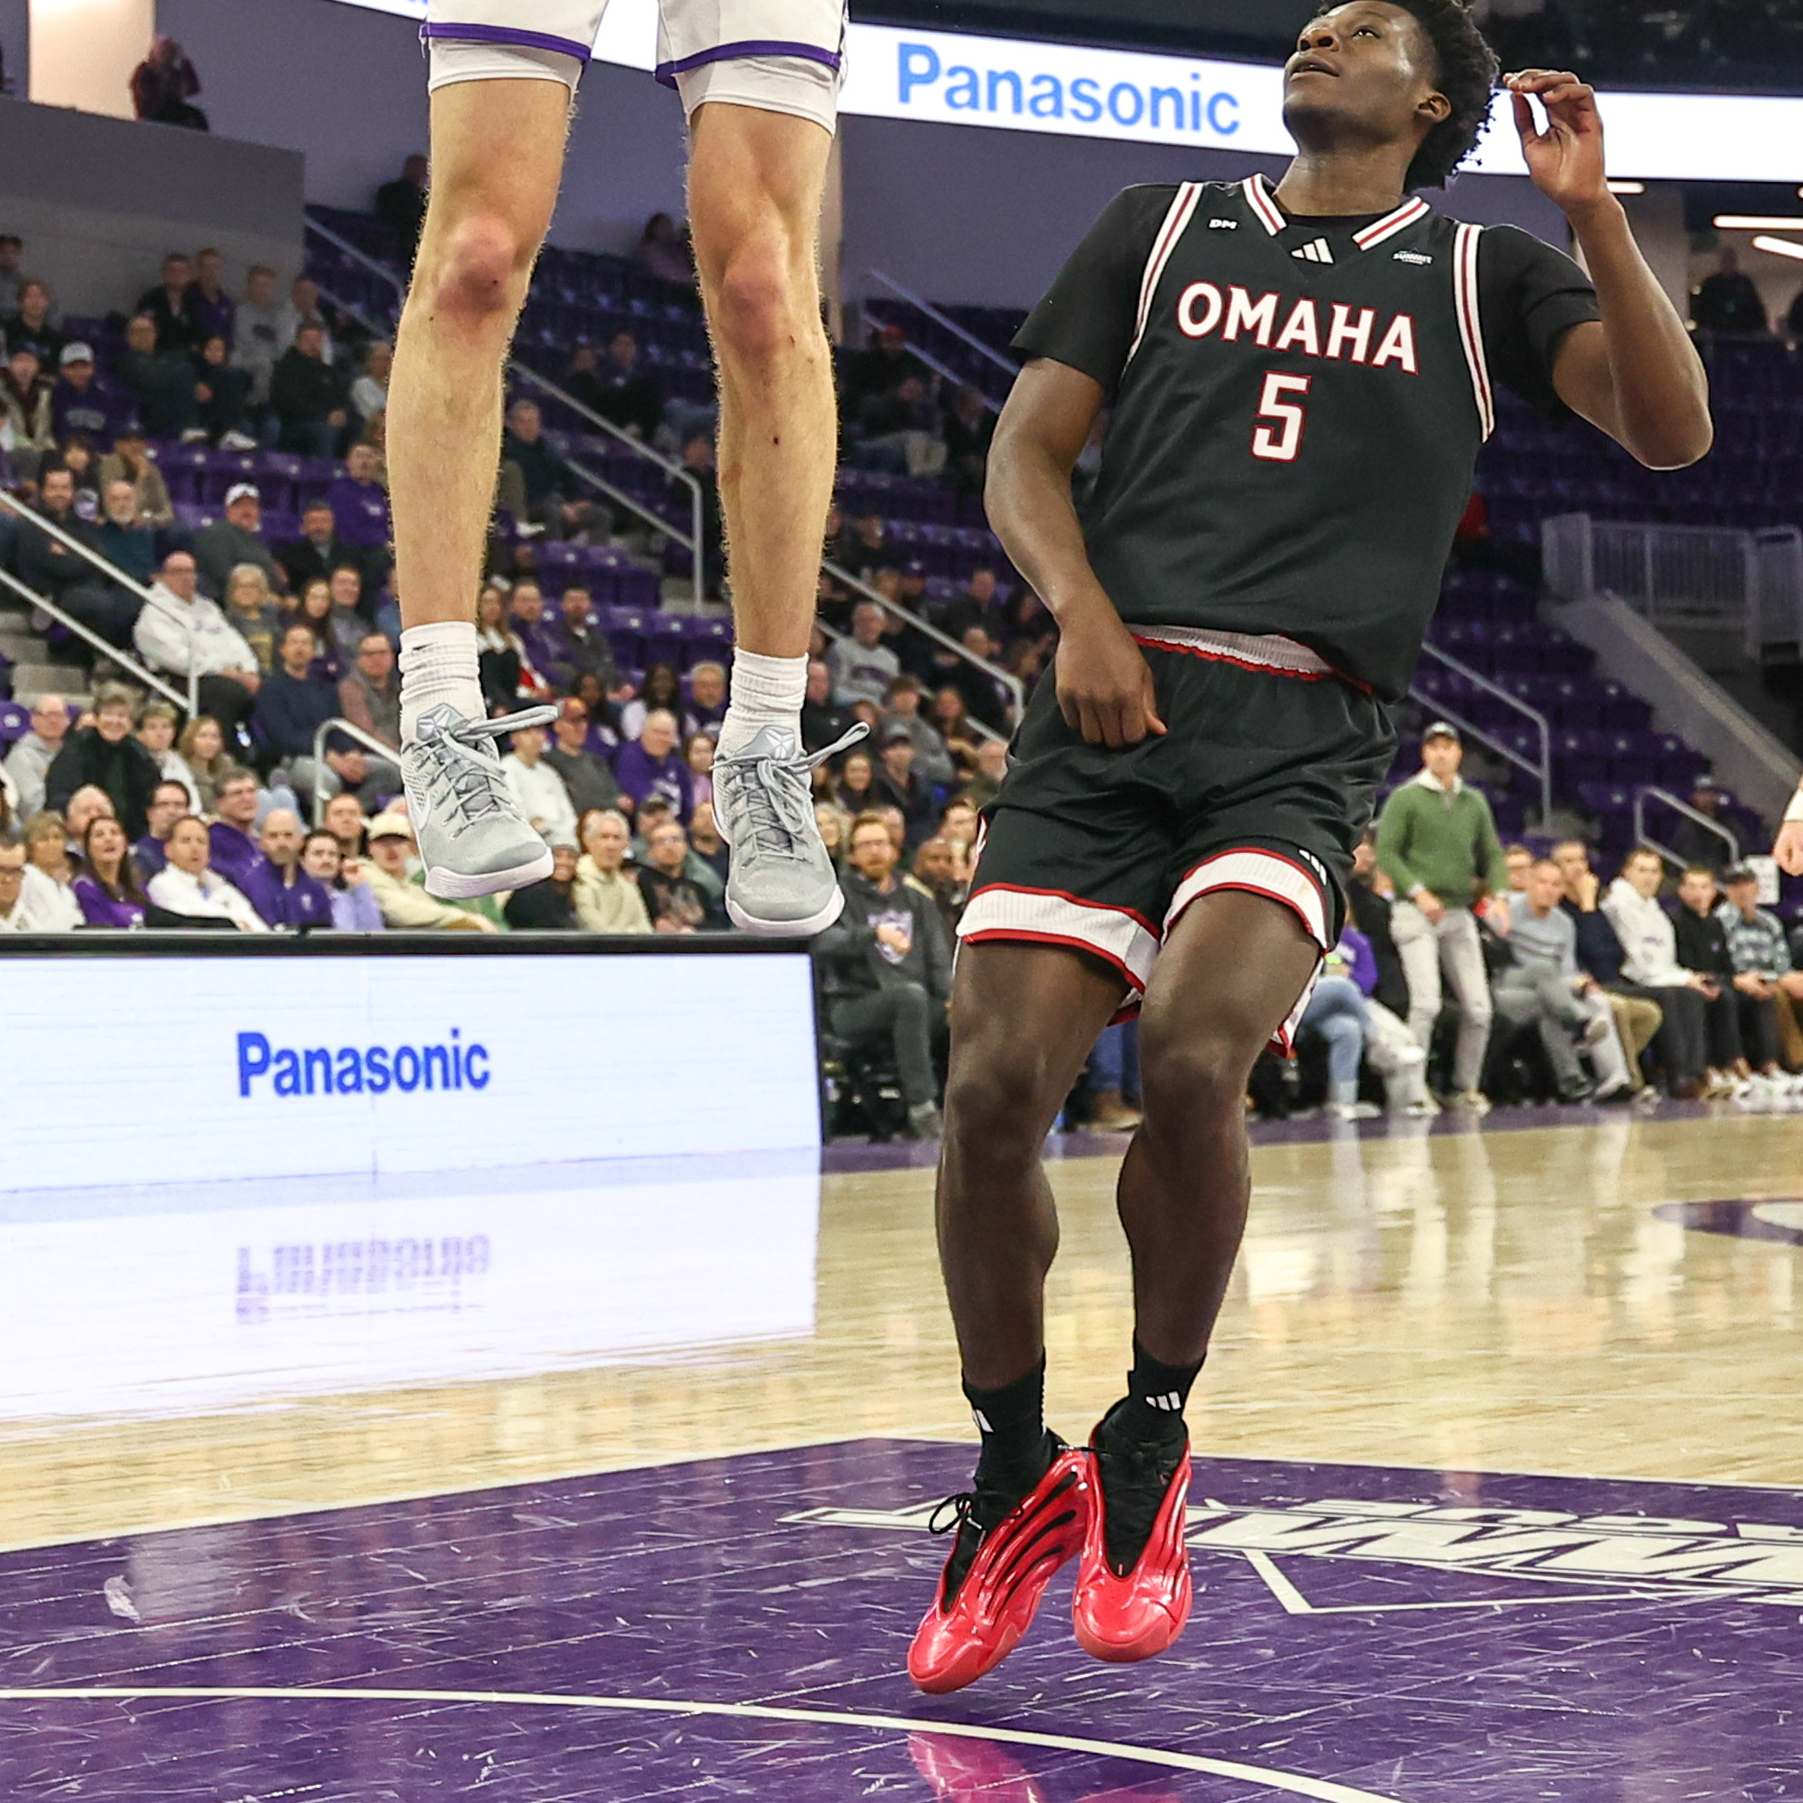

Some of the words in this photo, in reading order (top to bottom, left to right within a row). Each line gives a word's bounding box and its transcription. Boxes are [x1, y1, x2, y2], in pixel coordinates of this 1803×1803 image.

[896, 41, 1241, 137] Panasonic
[1208, 218, 1238, 230] DM
[1176, 280, 1420, 376] OMAHA
[1250, 370, 1312, 463] 5
[237, 1027, 491, 1097] Panasonic
